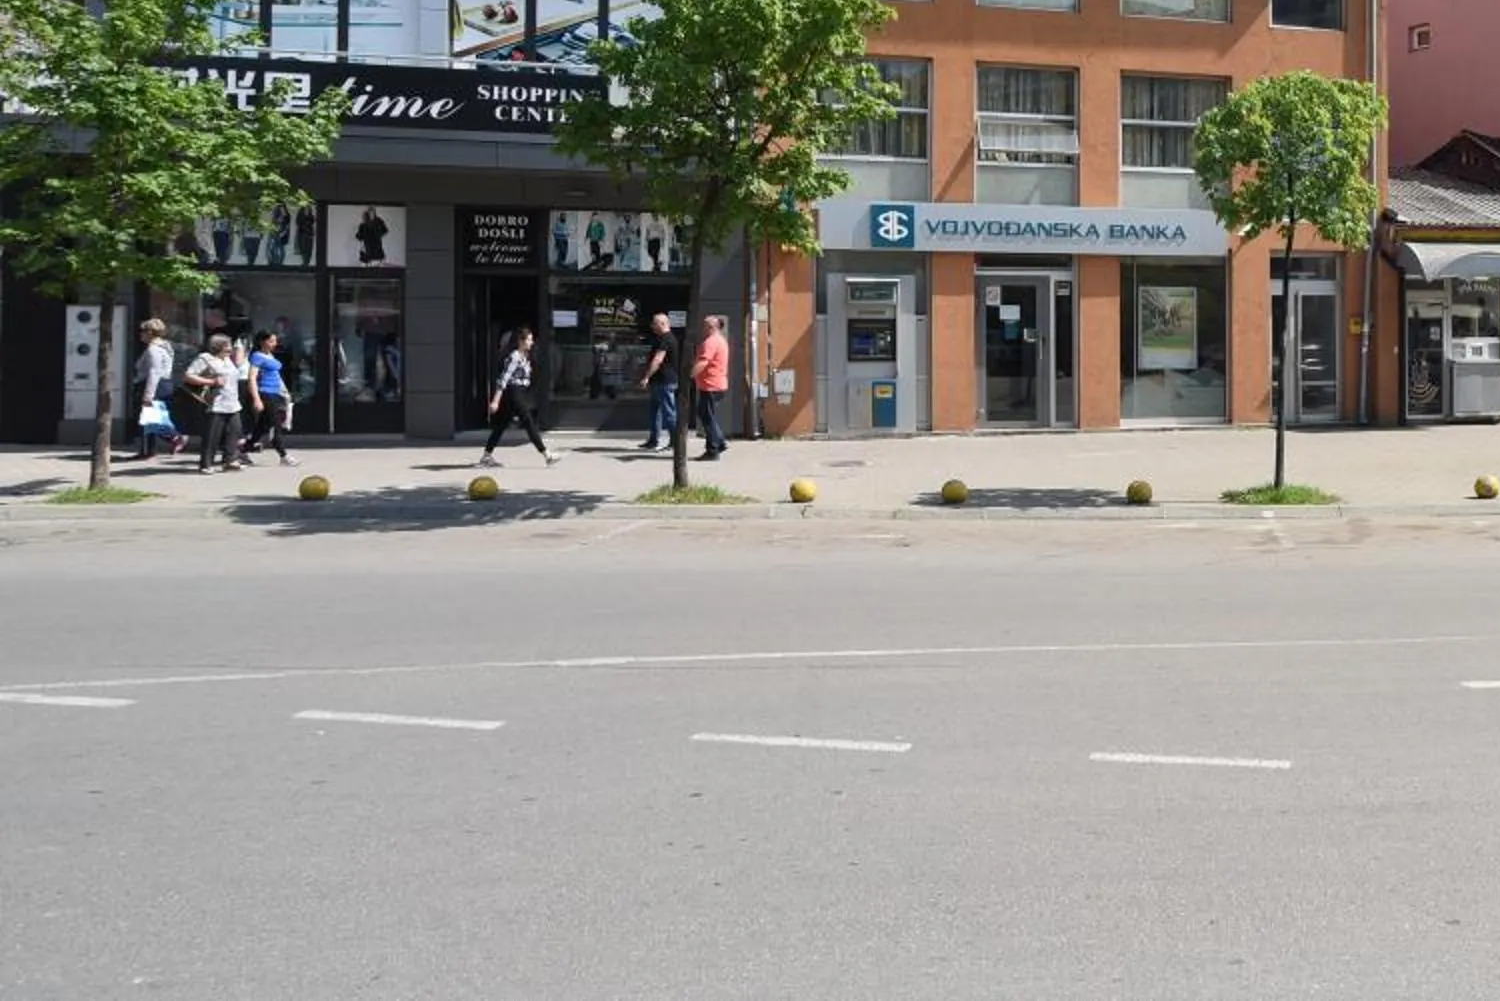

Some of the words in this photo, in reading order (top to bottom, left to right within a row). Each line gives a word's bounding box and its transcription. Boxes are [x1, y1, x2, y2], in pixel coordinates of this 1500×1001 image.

[477, 84, 600, 103] SHOPPIN
[495, 104, 573, 123] CENTE
[474, 214, 529, 226] DOBRO
[925, 218, 1100, 239] VOJVOĐANSKA
[1108, 223, 1187, 241] BANKA
[478, 226, 526, 238] DOŠLI
